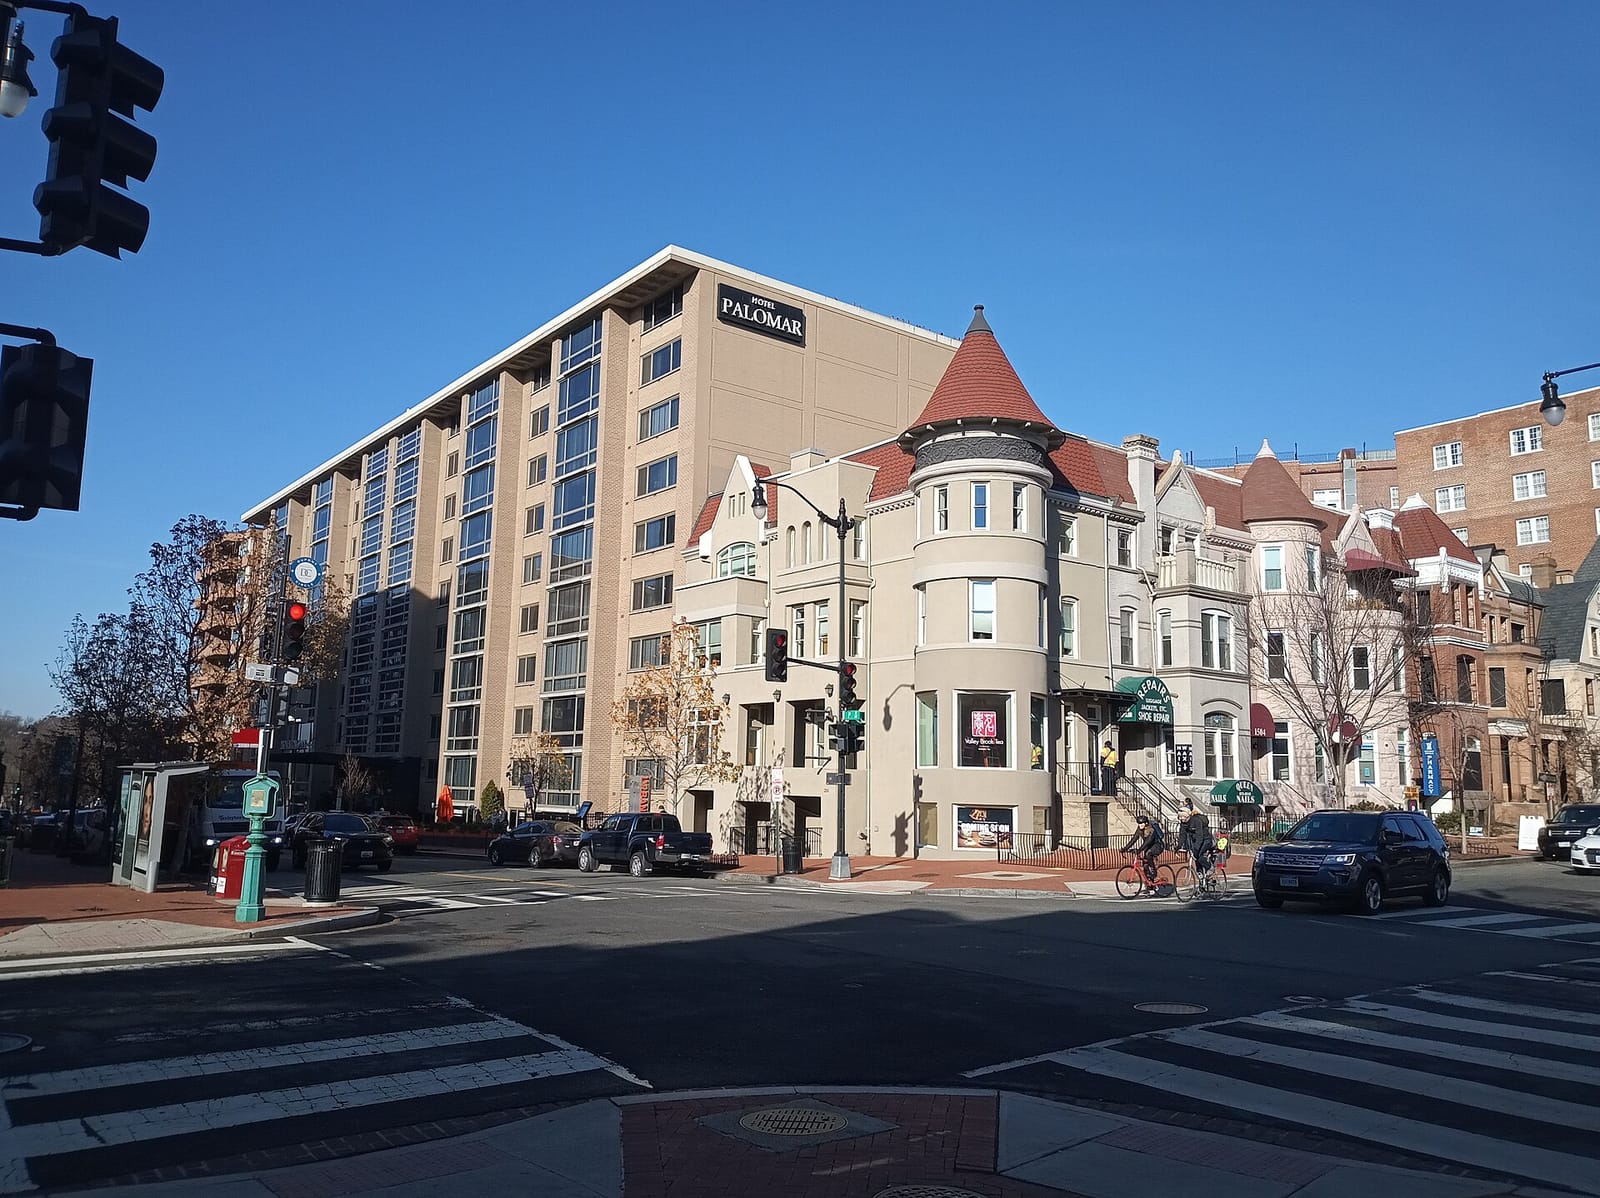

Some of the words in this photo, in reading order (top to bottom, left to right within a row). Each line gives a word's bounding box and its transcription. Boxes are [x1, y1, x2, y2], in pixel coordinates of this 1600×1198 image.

[751, 296, 776, 310] HOTEL
[721, 297, 803, 336] PALOMAR
[1137, 679, 1171, 703] REPAIRS
[1138, 711, 1152, 722] SHOE
[1153, 712, 1170, 723] REPAIR
[964, 737, 980, 746] Valley
[1236, 795, 1256, 804] NAILS
[960, 822, 989, 833] COMING
[990, 823, 1010, 833] SOON
